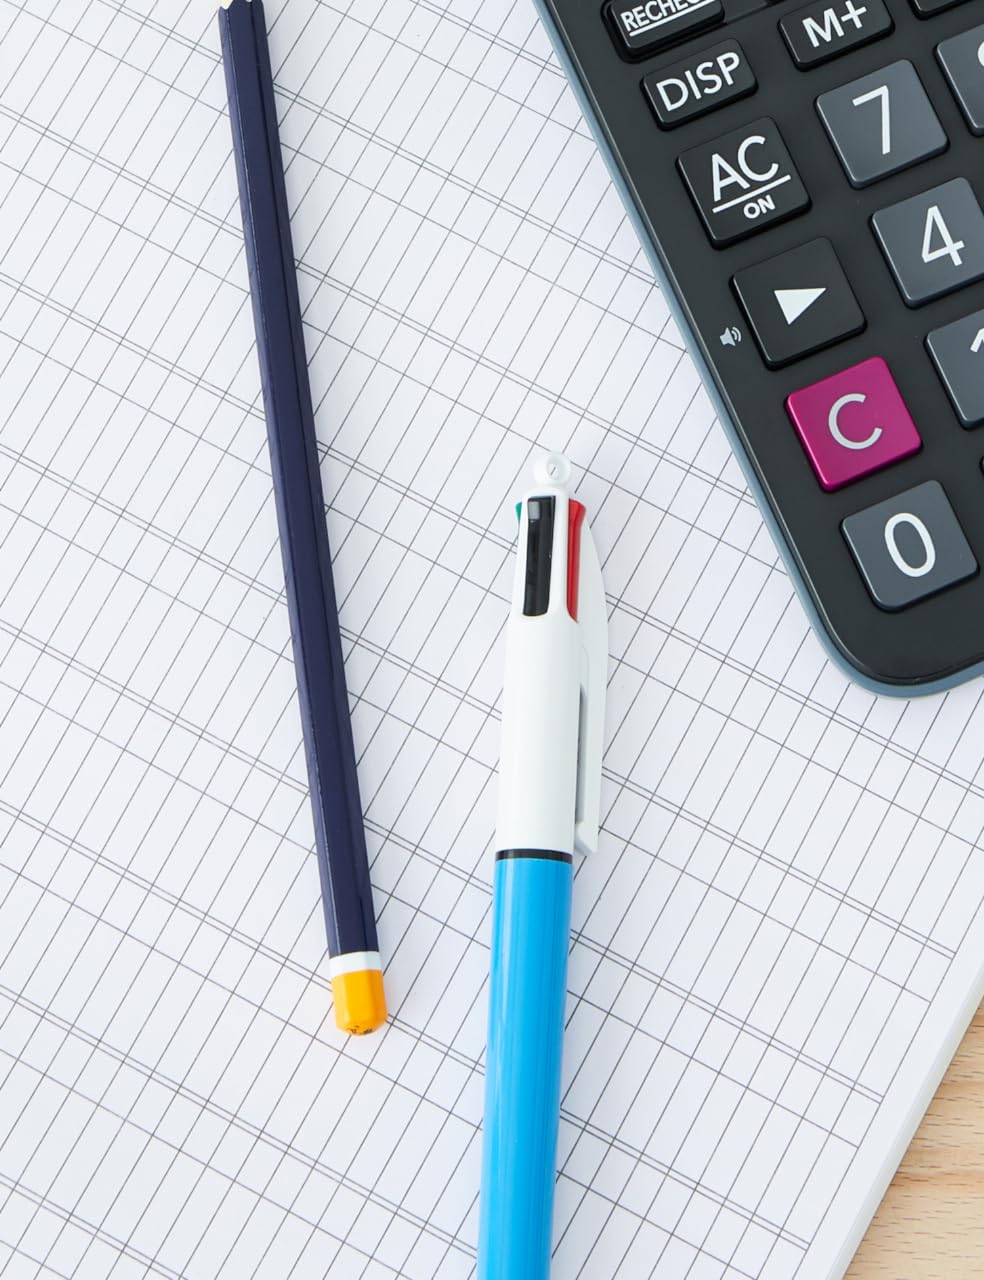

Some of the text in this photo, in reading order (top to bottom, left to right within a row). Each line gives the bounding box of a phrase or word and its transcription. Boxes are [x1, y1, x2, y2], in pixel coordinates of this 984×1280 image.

[801, 0, 867, 48] M+
[655, 51, 741, 112] DISP
[851, 85, 890, 155] 7
[710, 134, 780, 202] AC
[743, 194, 776, 219] ON
[920, 205, 965, 267] 4
[827, 392, 883, 451] C
[883, 511, 936, 578] 0
